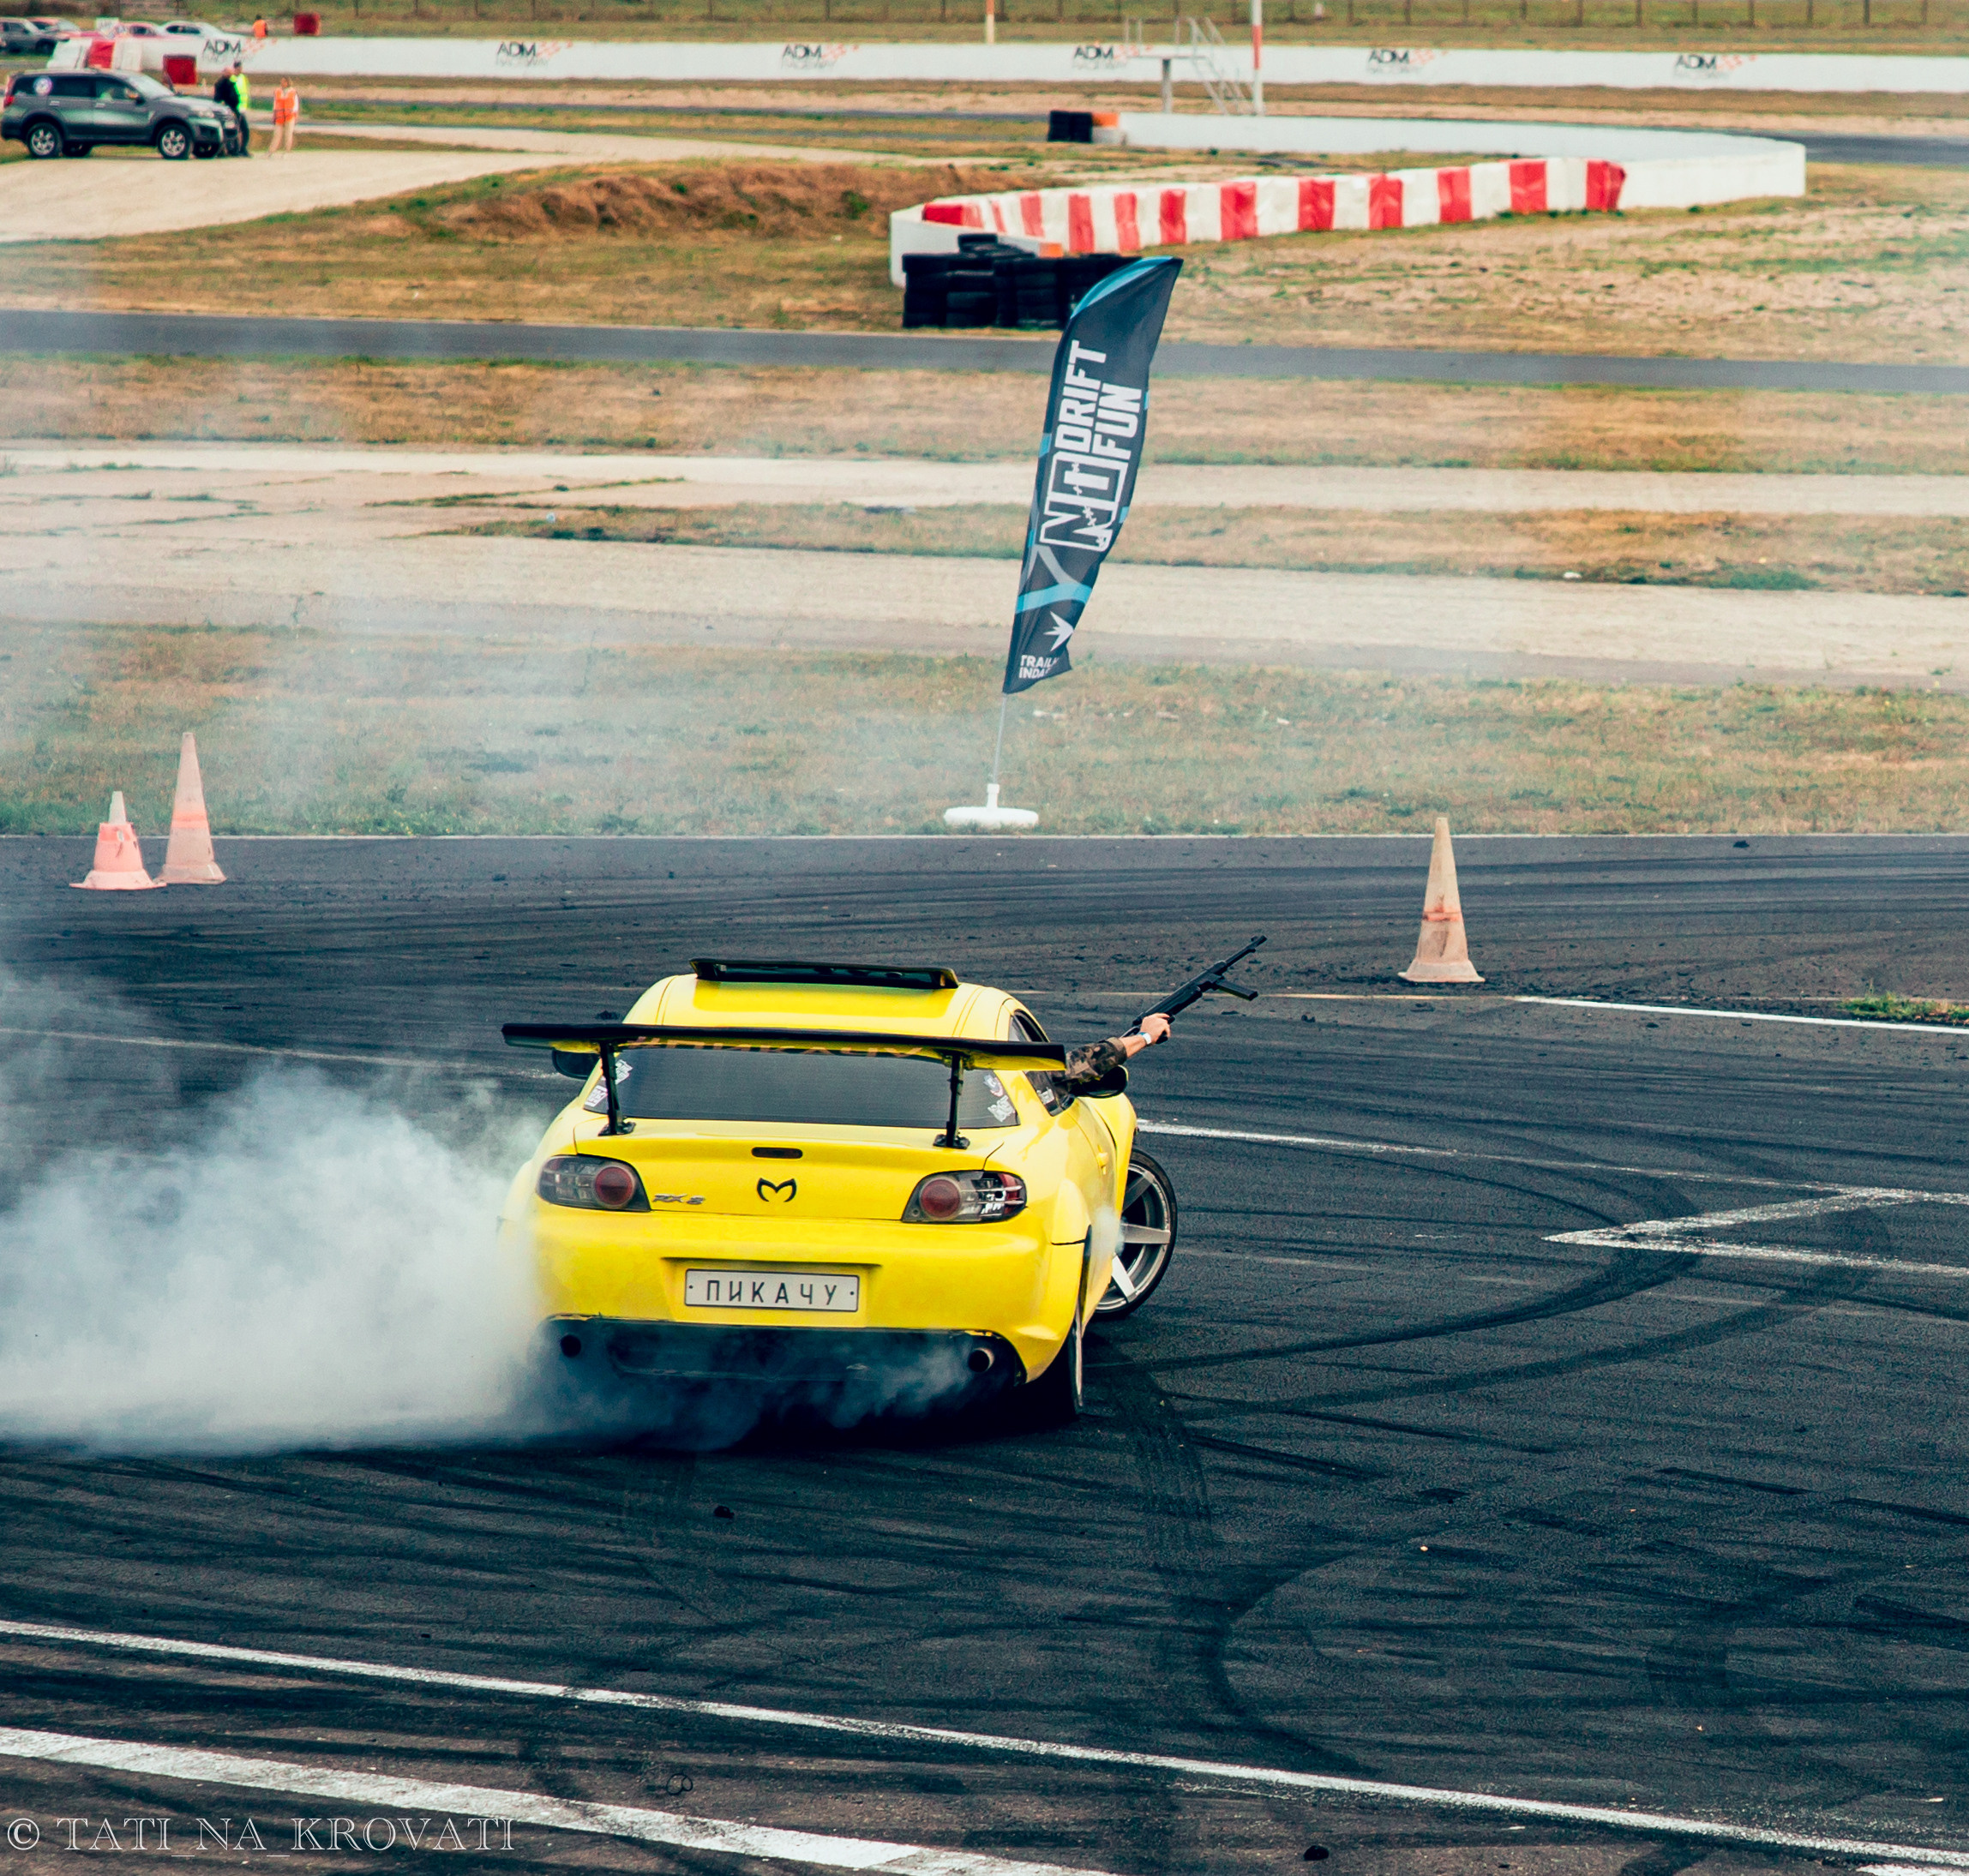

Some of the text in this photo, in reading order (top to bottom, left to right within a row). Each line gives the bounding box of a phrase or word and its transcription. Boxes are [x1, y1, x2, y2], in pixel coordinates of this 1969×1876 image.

[202, 39, 242, 54] ADM
[496, 41, 537, 57] ADM
[782, 44, 823, 59] ADM
[1073, 46, 1114, 60] ADM
[1369, 49, 1410, 64] ADM
[1674, 54, 1718, 69] ADM
[1055, 339, 1107, 453] DRIFT
[1091, 382, 1142, 460] FUN
[706, 1280, 837, 1305] ПИКАЧУ
